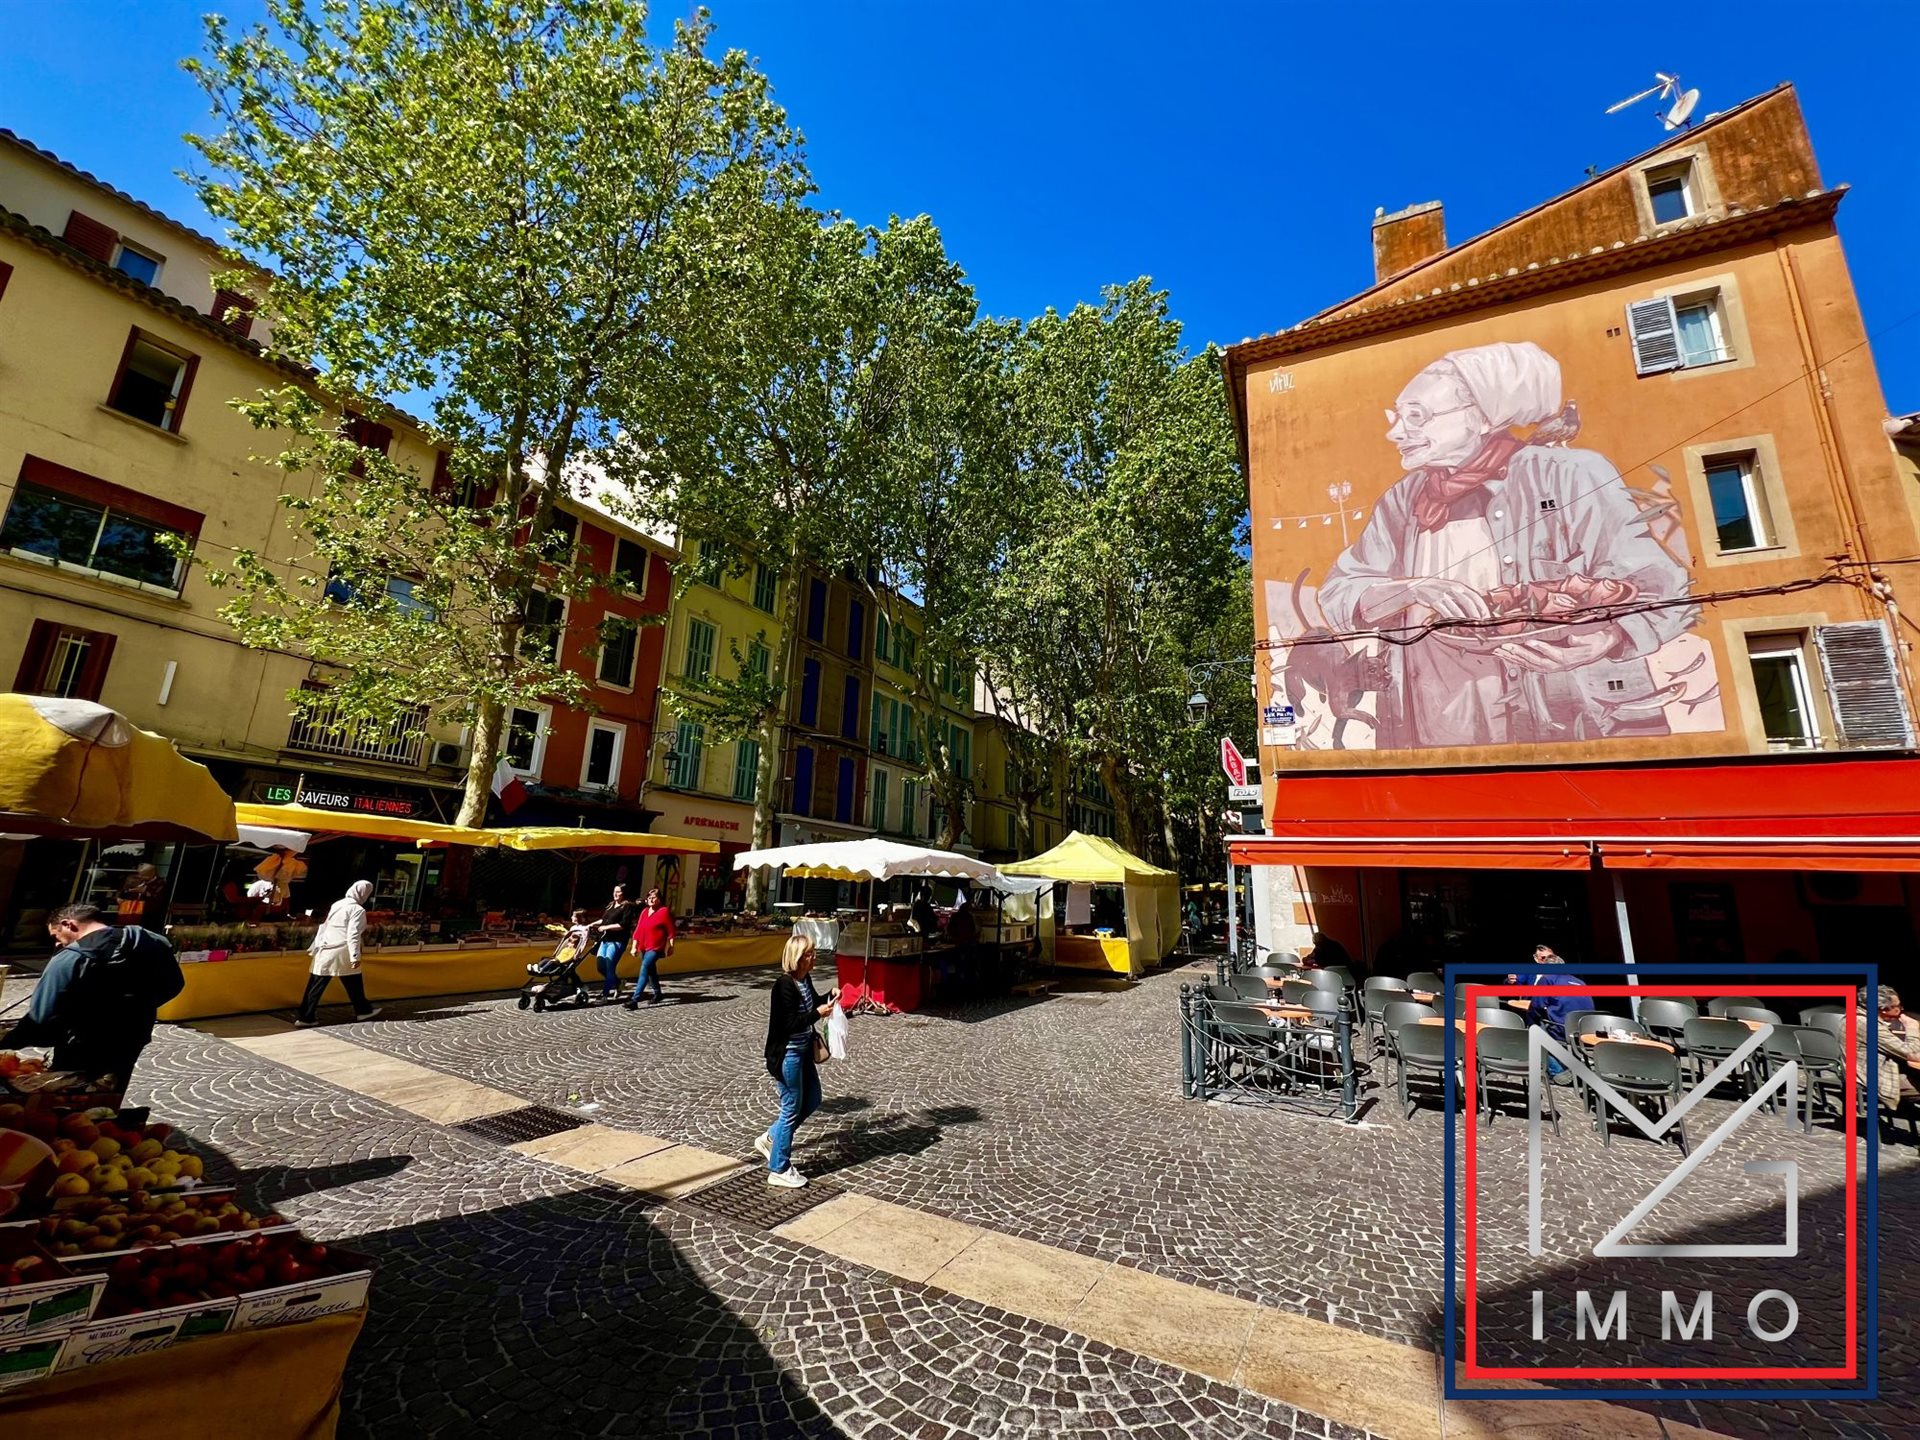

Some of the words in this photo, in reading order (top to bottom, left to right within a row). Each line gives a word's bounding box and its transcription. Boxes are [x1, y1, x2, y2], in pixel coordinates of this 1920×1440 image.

[1227, 748, 1242, 781] TABAC
[267, 787, 291, 801] LES
[298, 791, 350, 808] SAVEURS
[353, 797, 412, 814] ITALIENNES
